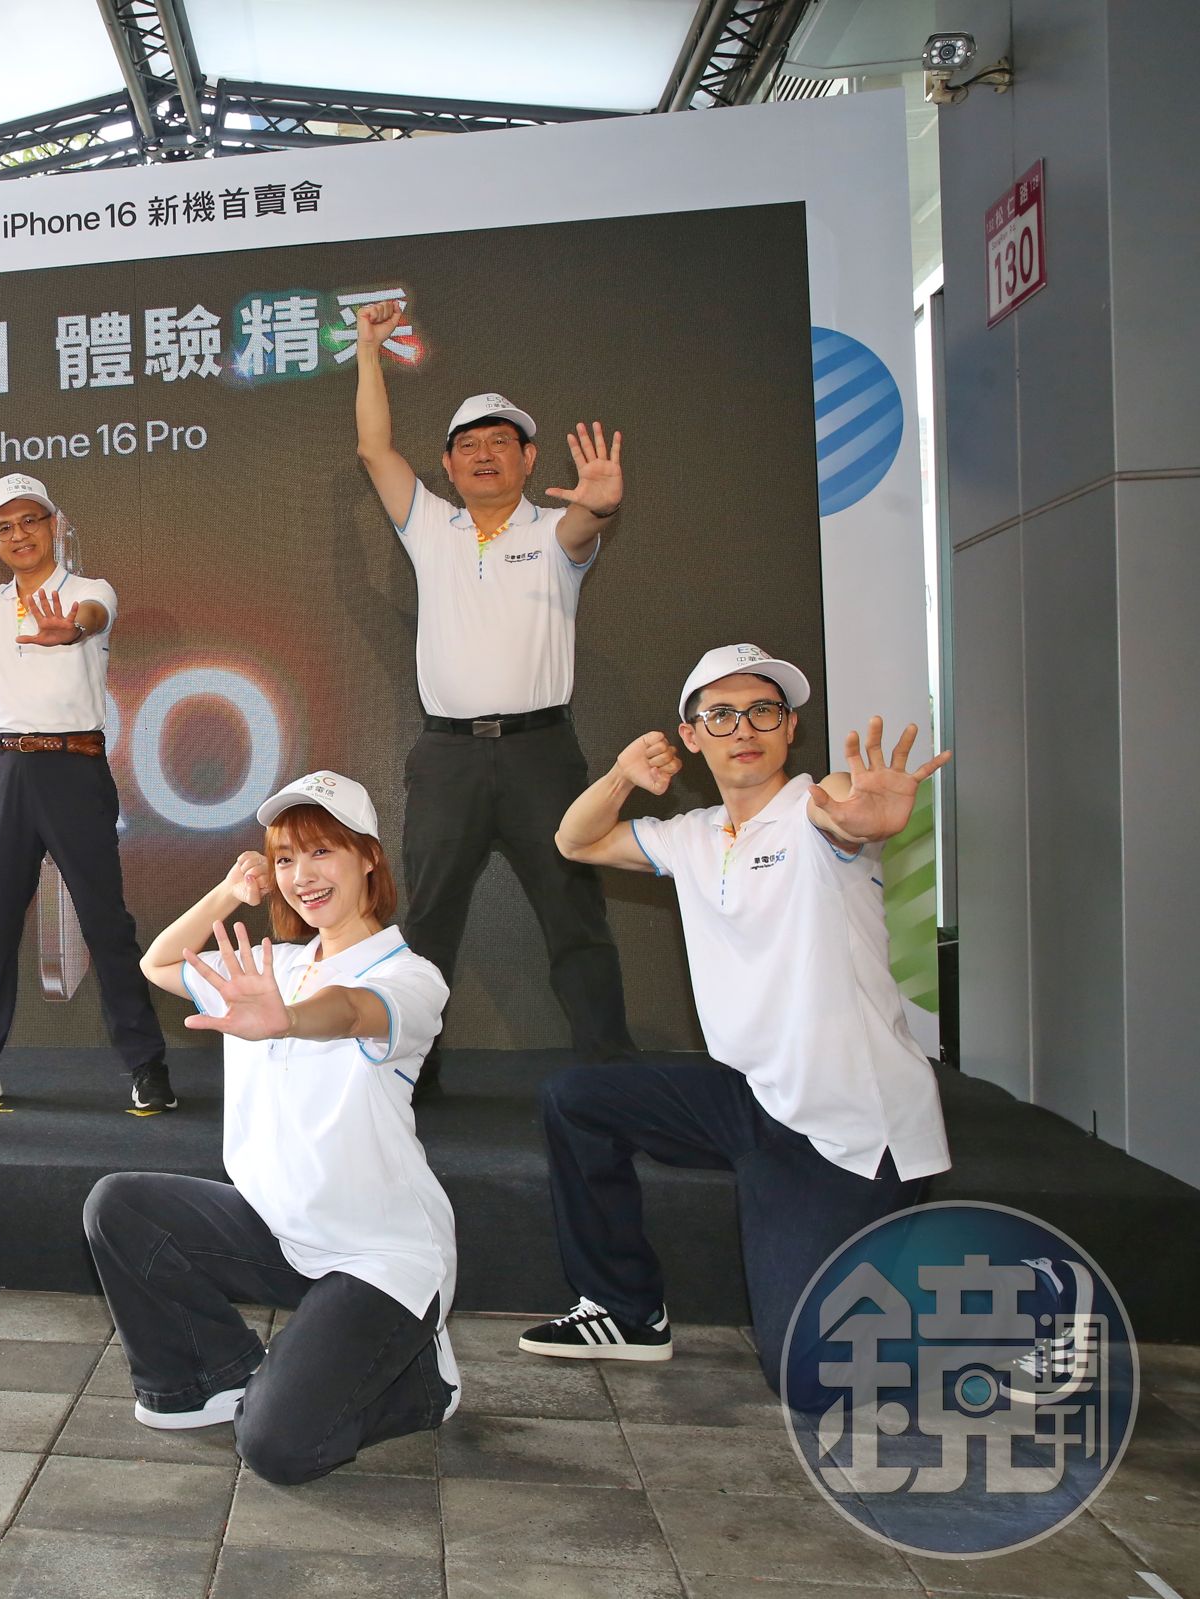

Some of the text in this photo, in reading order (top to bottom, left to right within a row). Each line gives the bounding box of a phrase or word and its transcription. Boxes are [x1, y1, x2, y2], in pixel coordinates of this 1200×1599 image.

[2, 180, 324, 239] iPhone 16 新機首賣會
[994, 226, 1034, 305] 130
[96, 422, 137, 456] 16
[146, 420, 208, 453] Pro
[7, 477, 31, 485] ESG
[302, 776, 337, 787] ESG
